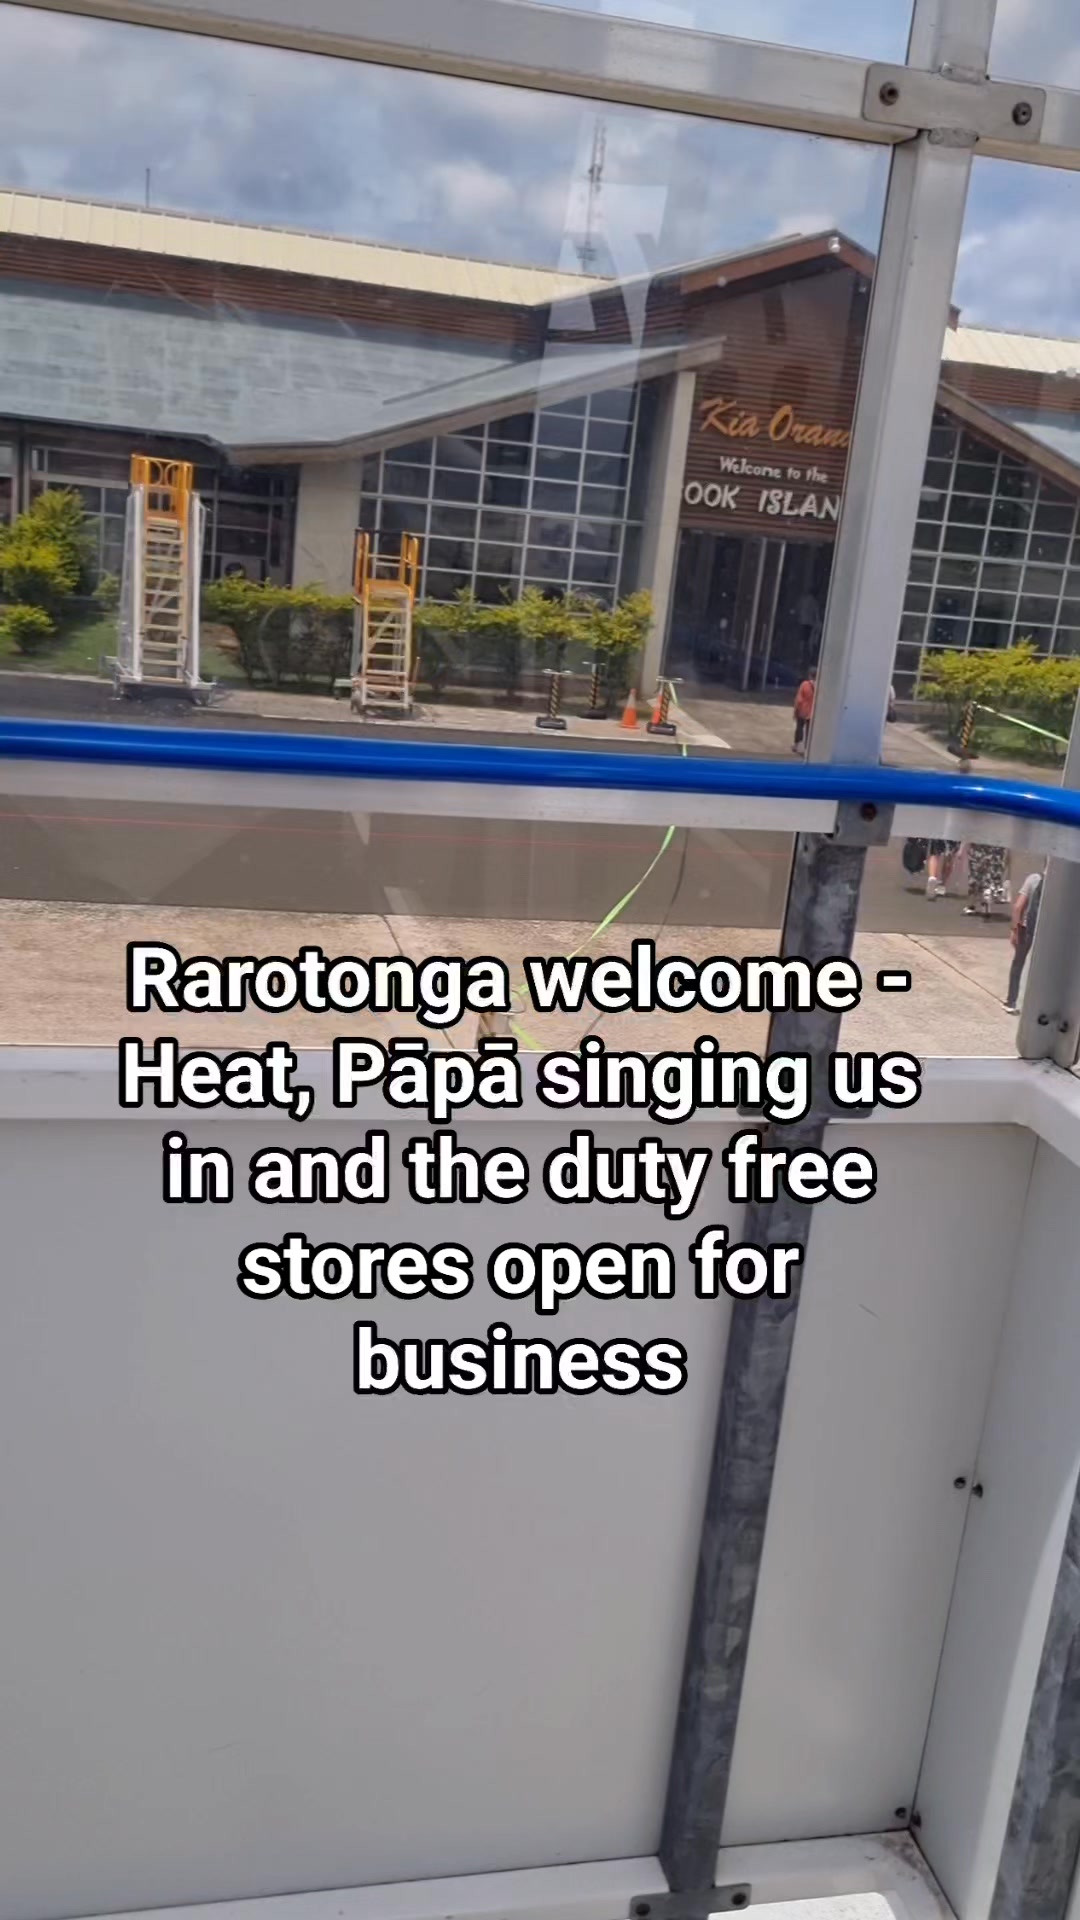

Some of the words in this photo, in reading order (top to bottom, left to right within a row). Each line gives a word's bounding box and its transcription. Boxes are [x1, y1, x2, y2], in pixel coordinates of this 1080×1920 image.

[700, 396, 760, 438] Kia
[719, 455, 782, 480] Welcome
[787, 465, 801, 481] to
[805, 465, 829, 484] the
[684, 480, 741, 510] OOK
[757, 488, 841, 522] ISLAN
